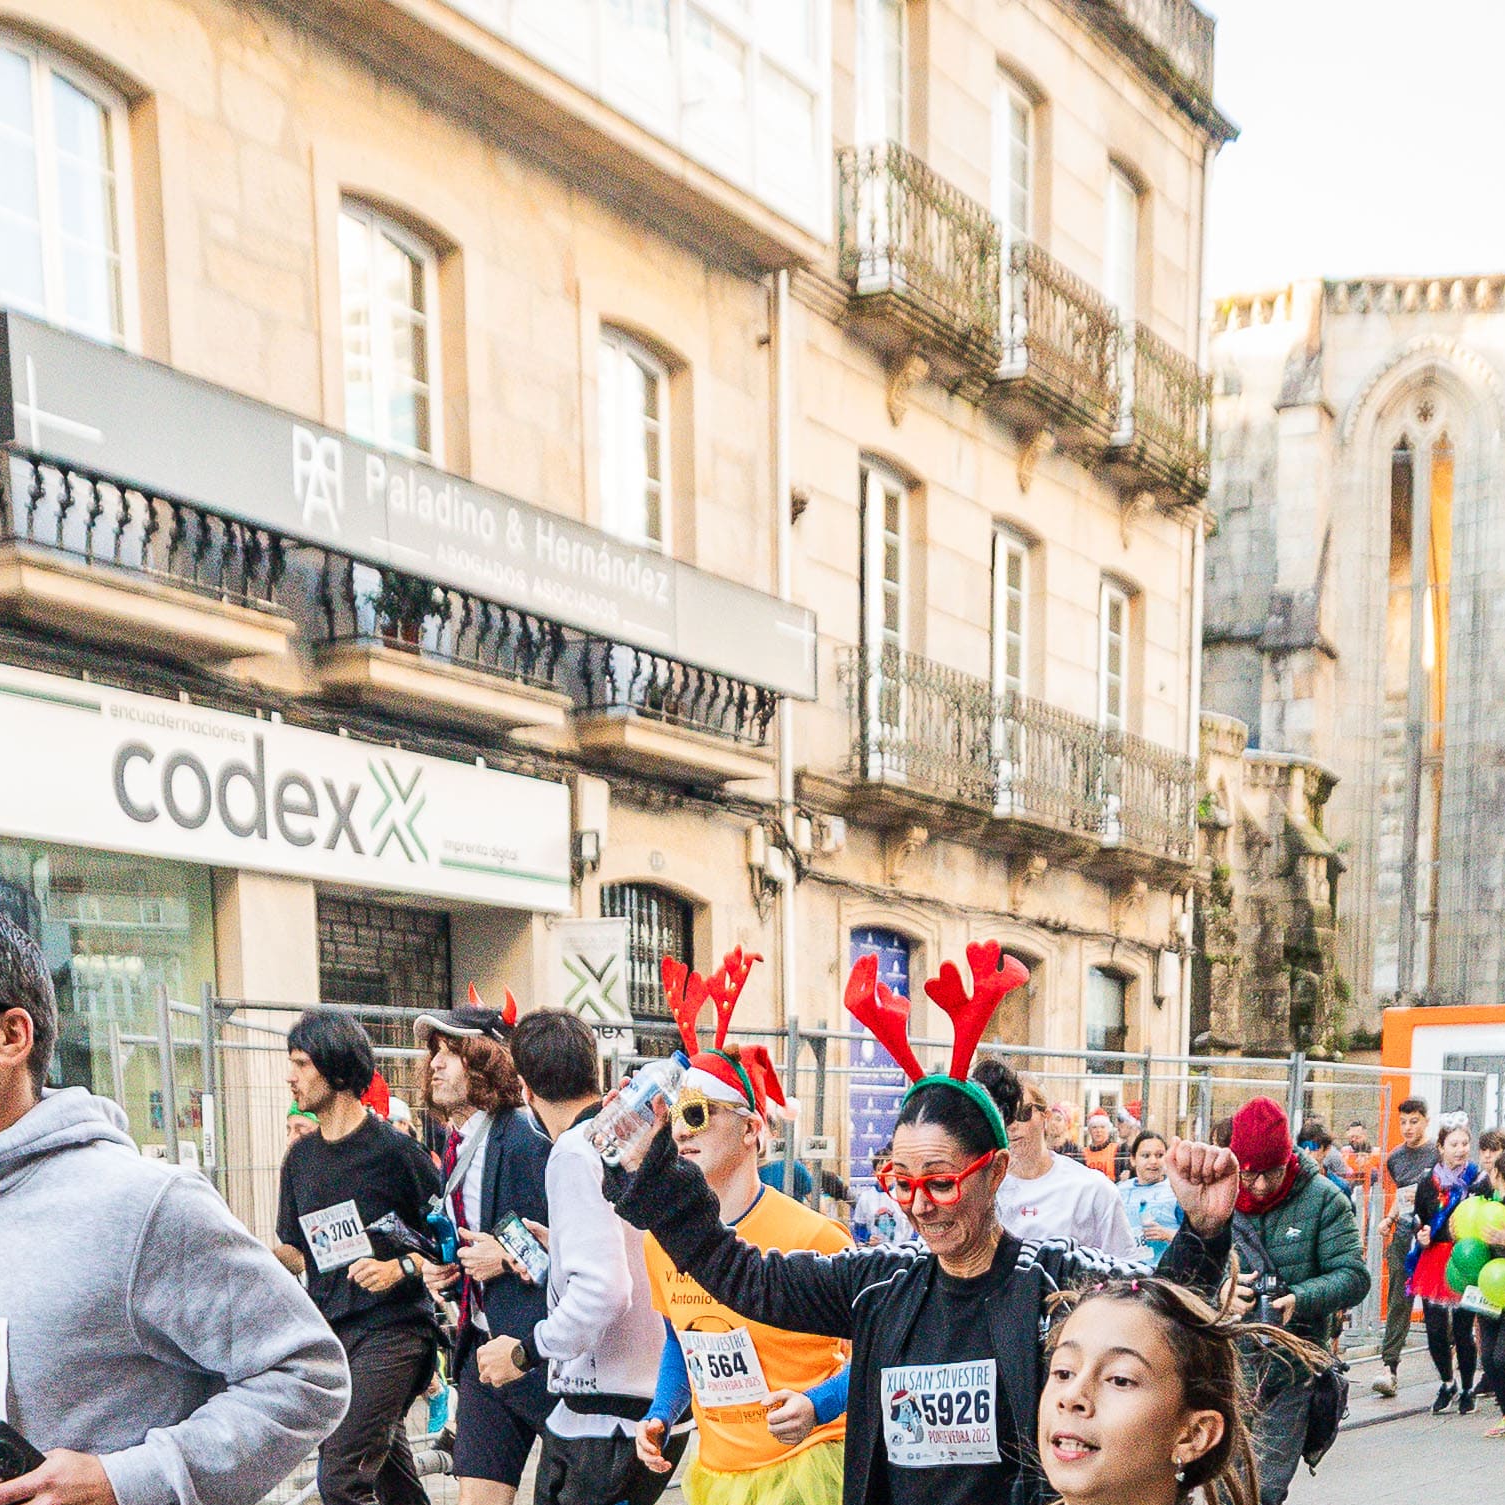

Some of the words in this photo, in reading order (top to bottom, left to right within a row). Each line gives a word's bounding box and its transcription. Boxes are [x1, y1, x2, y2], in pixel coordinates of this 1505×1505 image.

[365, 453, 493, 541] Paladino
[505, 507, 526, 550] &
[535, 516, 670, 606] Hernández
[435, 541, 528, 594] ABOGADOS
[531, 574, 619, 622] ASOCIADOS
[109, 702, 247, 744] encuadernaciones
[112, 732, 366, 856] codex
[442, 838, 487, 860] imprenta
[490, 845, 520, 865] digital
[329, 1217, 359, 1242] 3701
[670, 1292, 712, 1305] Antonio
[705, 1332, 748, 1352] SILVESTRE
[707, 1351, 748, 1379] 564
[886, 1371, 907, 1393] XLII
[909, 1370, 934, 1391] SAN
[936, 1365, 991, 1390] SILVESTRE
[745, 1375, 762, 1388] 2025
[921, 1389, 991, 1427] 5926
[927, 1429, 970, 1445] PONTEVEDRA
[972, 1427, 992, 1444] 2025
